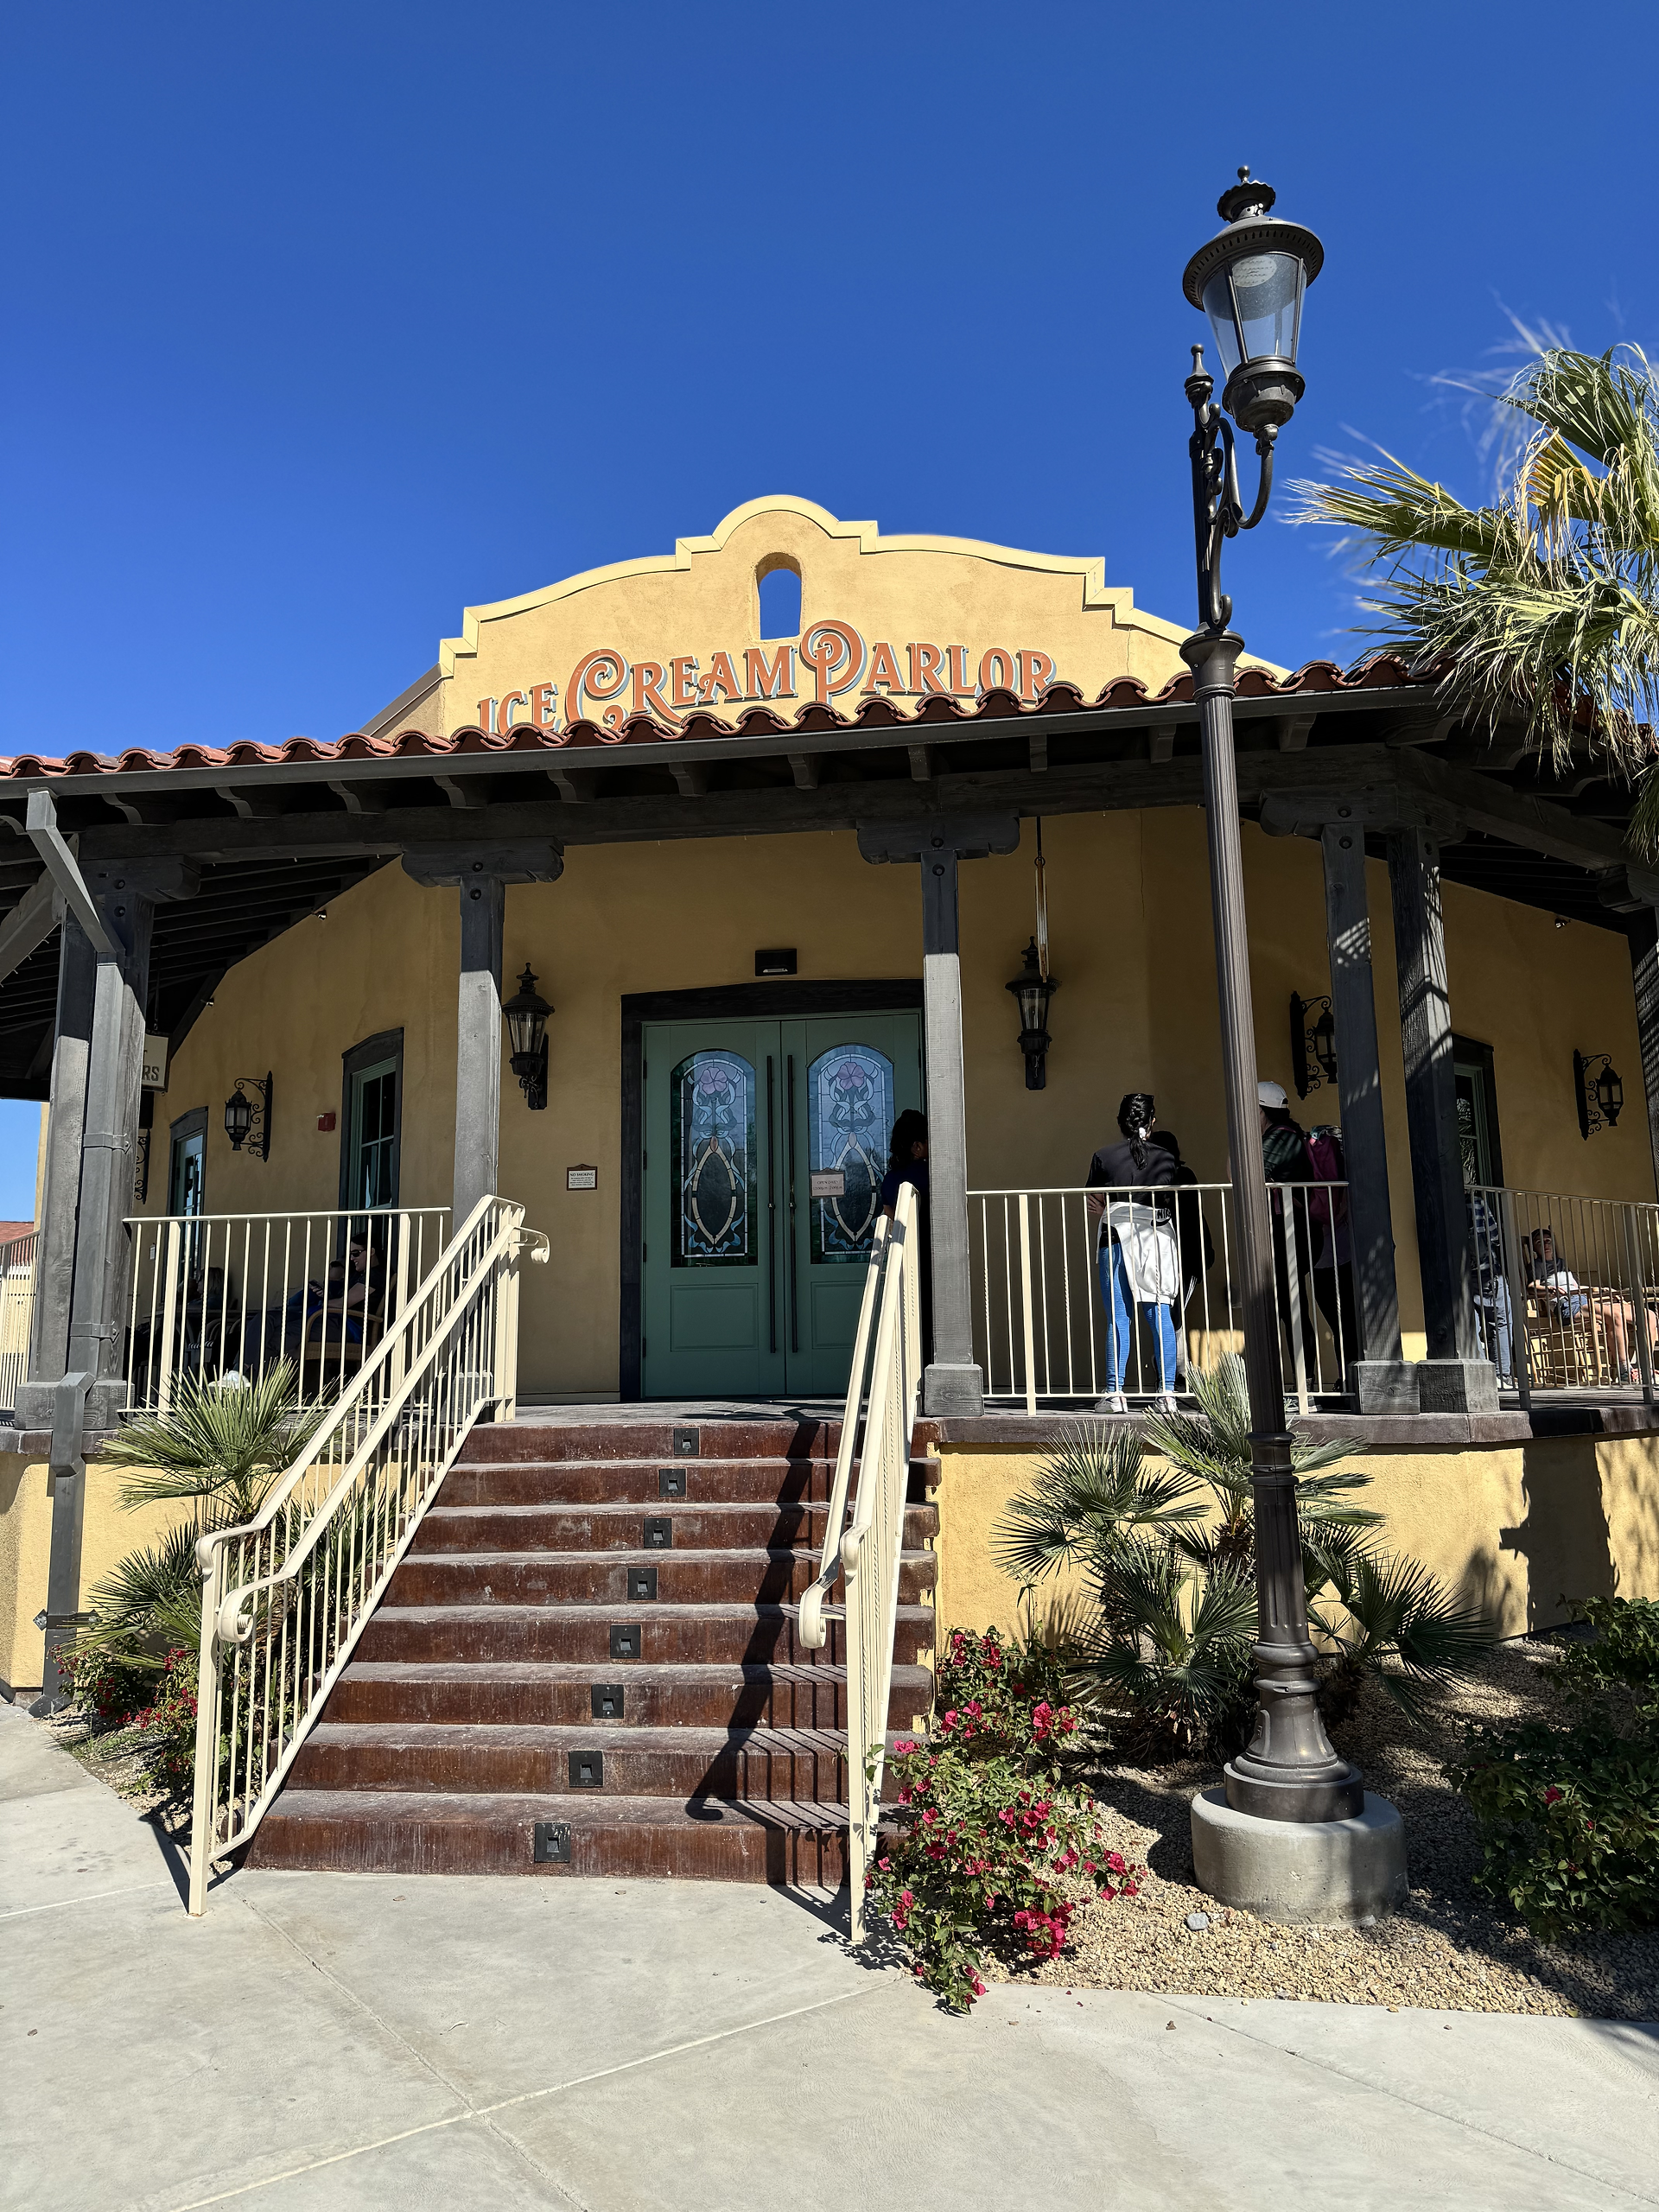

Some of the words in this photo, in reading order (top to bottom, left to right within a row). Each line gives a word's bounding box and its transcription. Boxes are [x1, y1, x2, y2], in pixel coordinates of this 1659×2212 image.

[477, 681, 558, 734] ICE
[564, 645, 798, 732] CREAM
[799, 620, 1056, 704] PARLOR
[143, 1065, 159, 1081] RS
